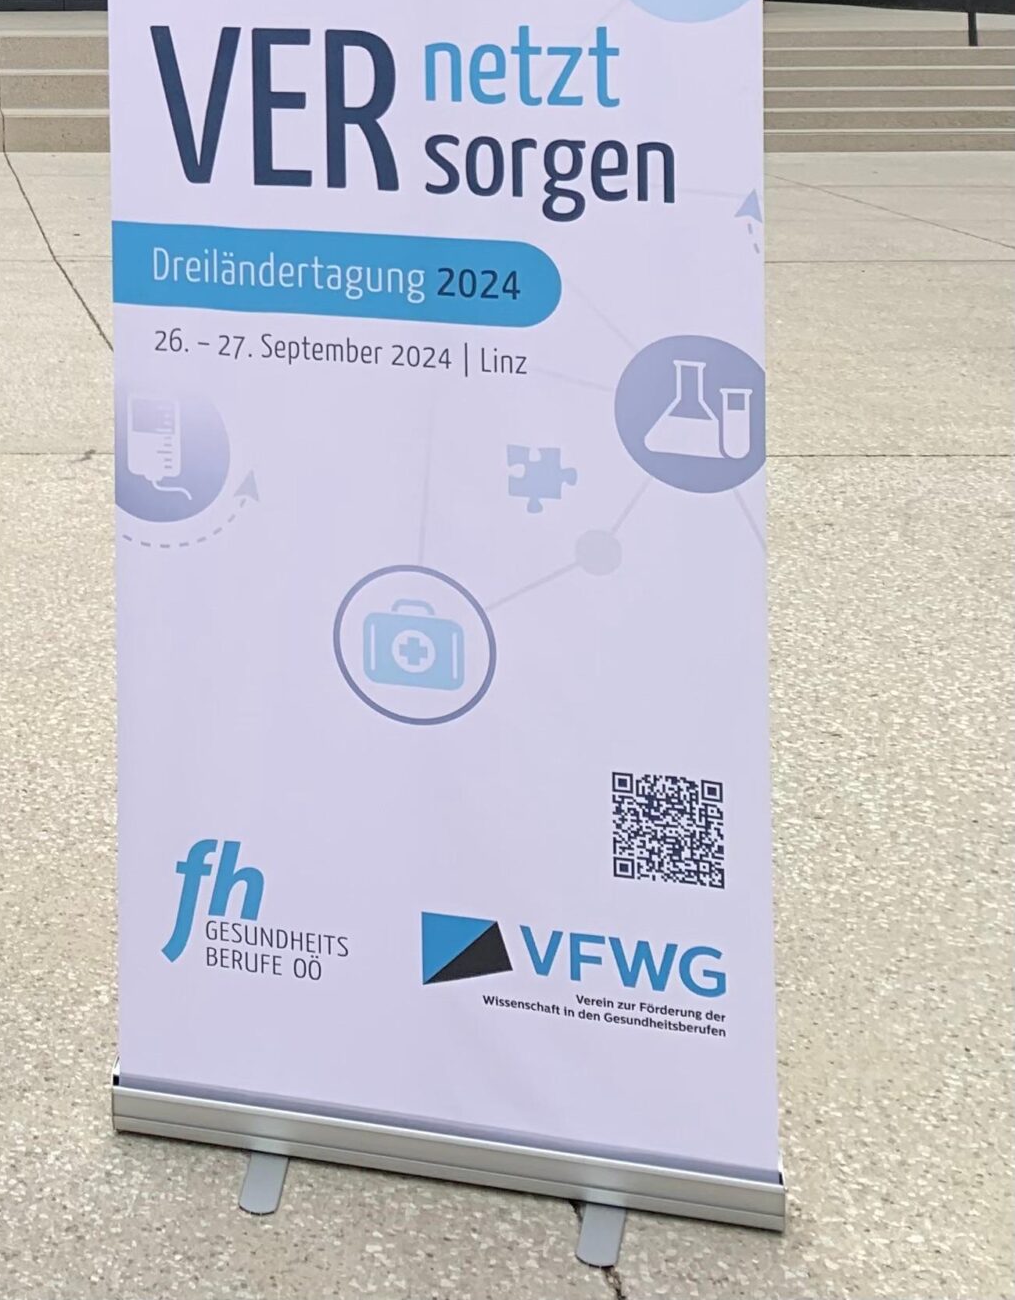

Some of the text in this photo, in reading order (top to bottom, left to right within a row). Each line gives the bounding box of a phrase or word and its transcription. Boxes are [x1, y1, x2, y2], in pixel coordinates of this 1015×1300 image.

[150, 24, 620, 192] VER netzt
[424, 134, 676, 223] sorgen
[153, 246, 522, 305] Dreiländertagung 2024
[154, 327, 189, 353] 26.
[217, 334, 253, 360] 27.
[260, 333, 384, 366] September
[390, 344, 453, 370] 2024
[480, 347, 528, 375] Linz
[161, 838, 266, 963] fh
[205, 920, 350, 958] GESUNDHEITS
[205, 946, 323, 981] BERUFE OÖ
[519, 924, 727, 999] VFWG
[482, 994, 727, 1038] Wissenschaft in den Gesundheitsberufen
[575, 994, 727, 1023] Verein zur Förderung der
